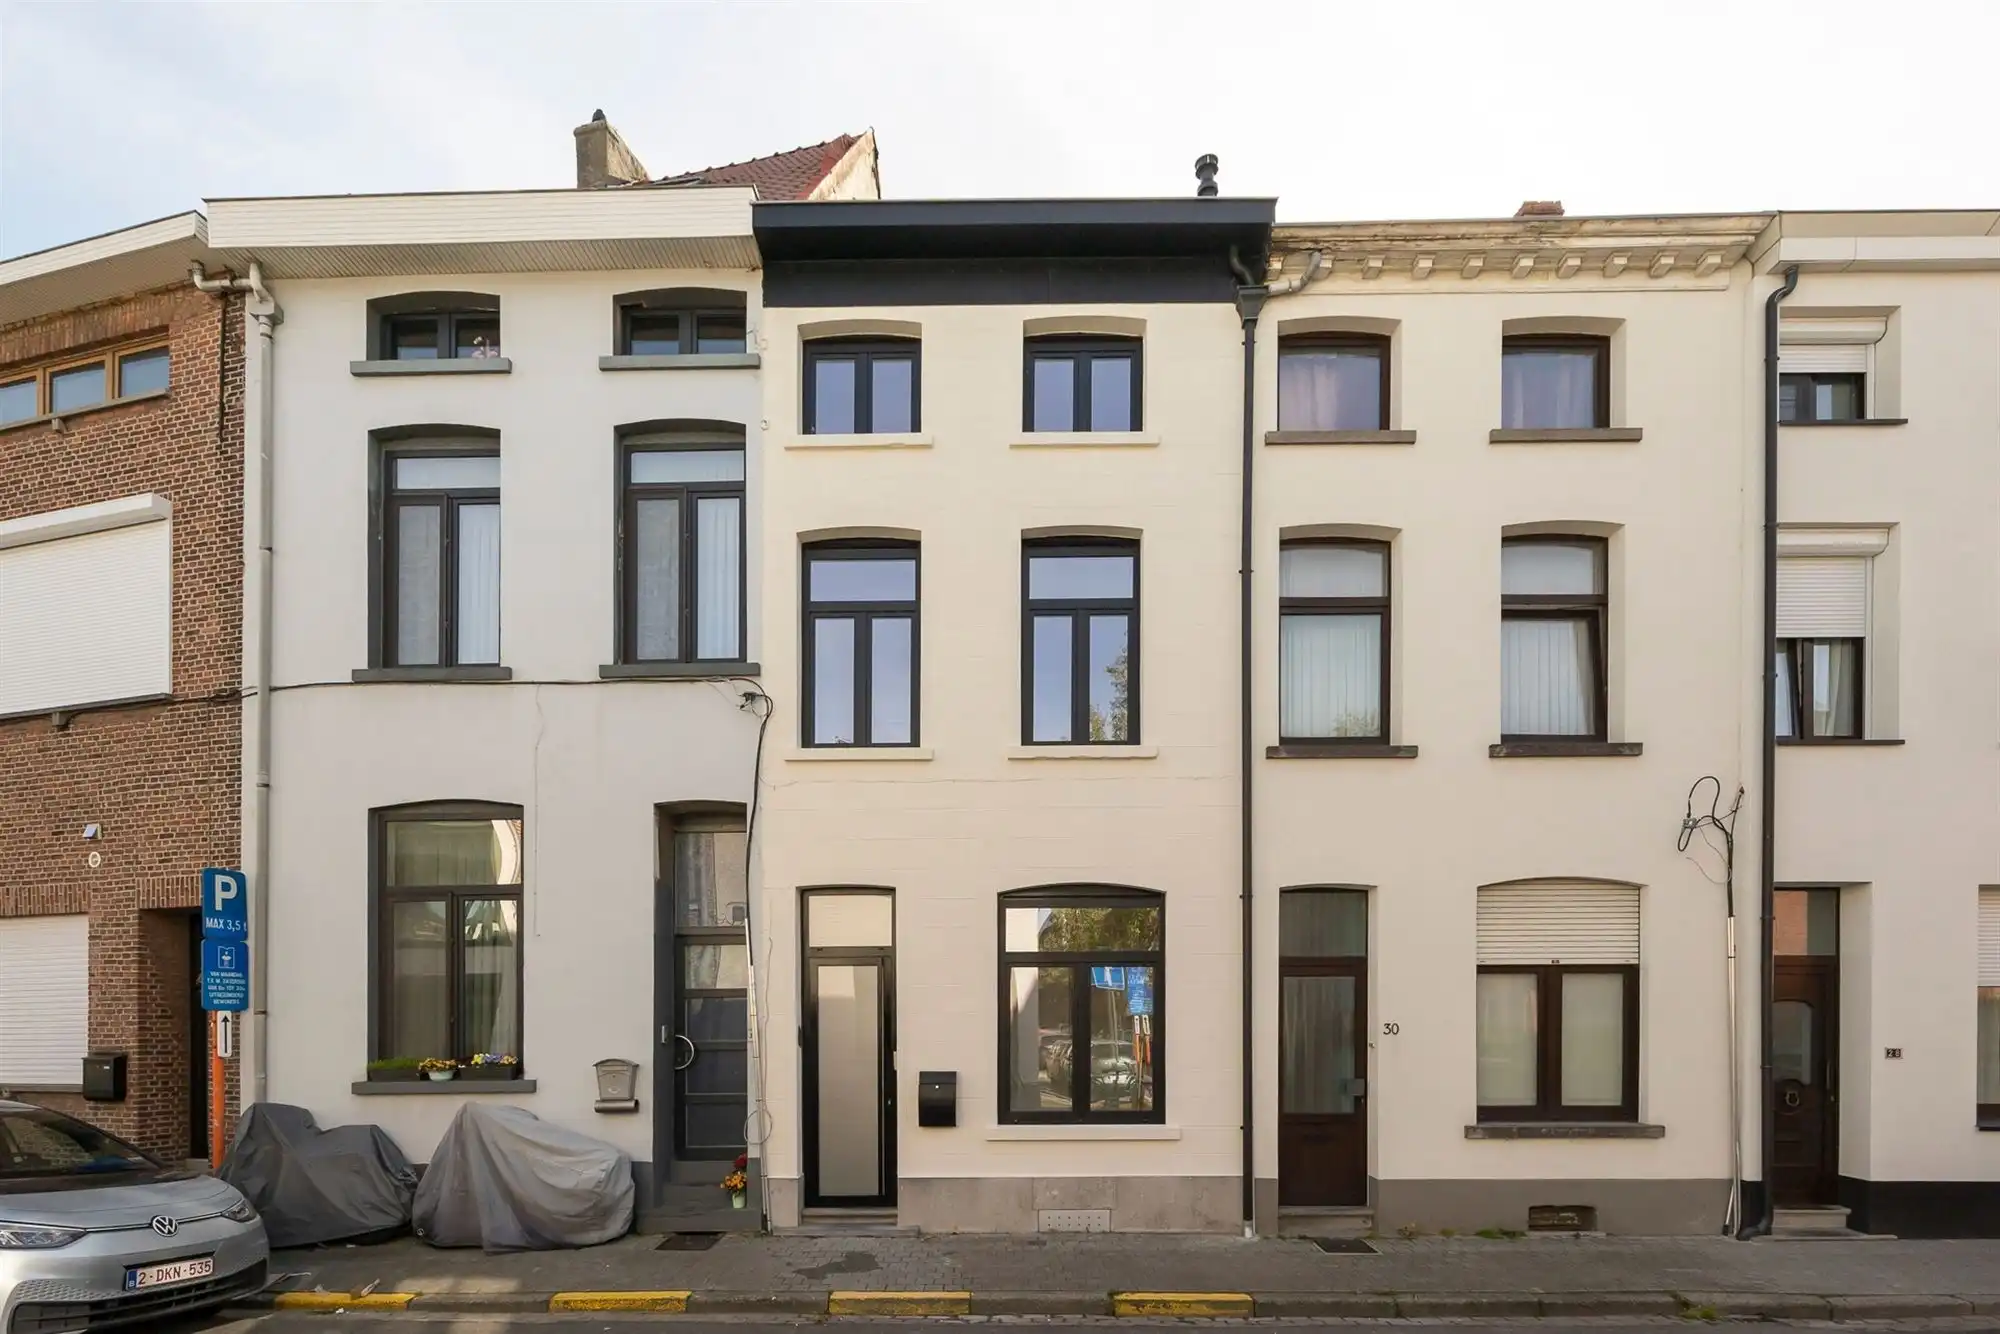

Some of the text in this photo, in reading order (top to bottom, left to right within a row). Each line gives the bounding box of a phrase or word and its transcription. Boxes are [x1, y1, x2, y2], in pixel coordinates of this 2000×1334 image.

[215, 874, 237, 911] P
[205, 917, 224, 930] MAX
[226, 919, 241, 932] 3,5
[1383, 1022, 1400, 1035] 30
